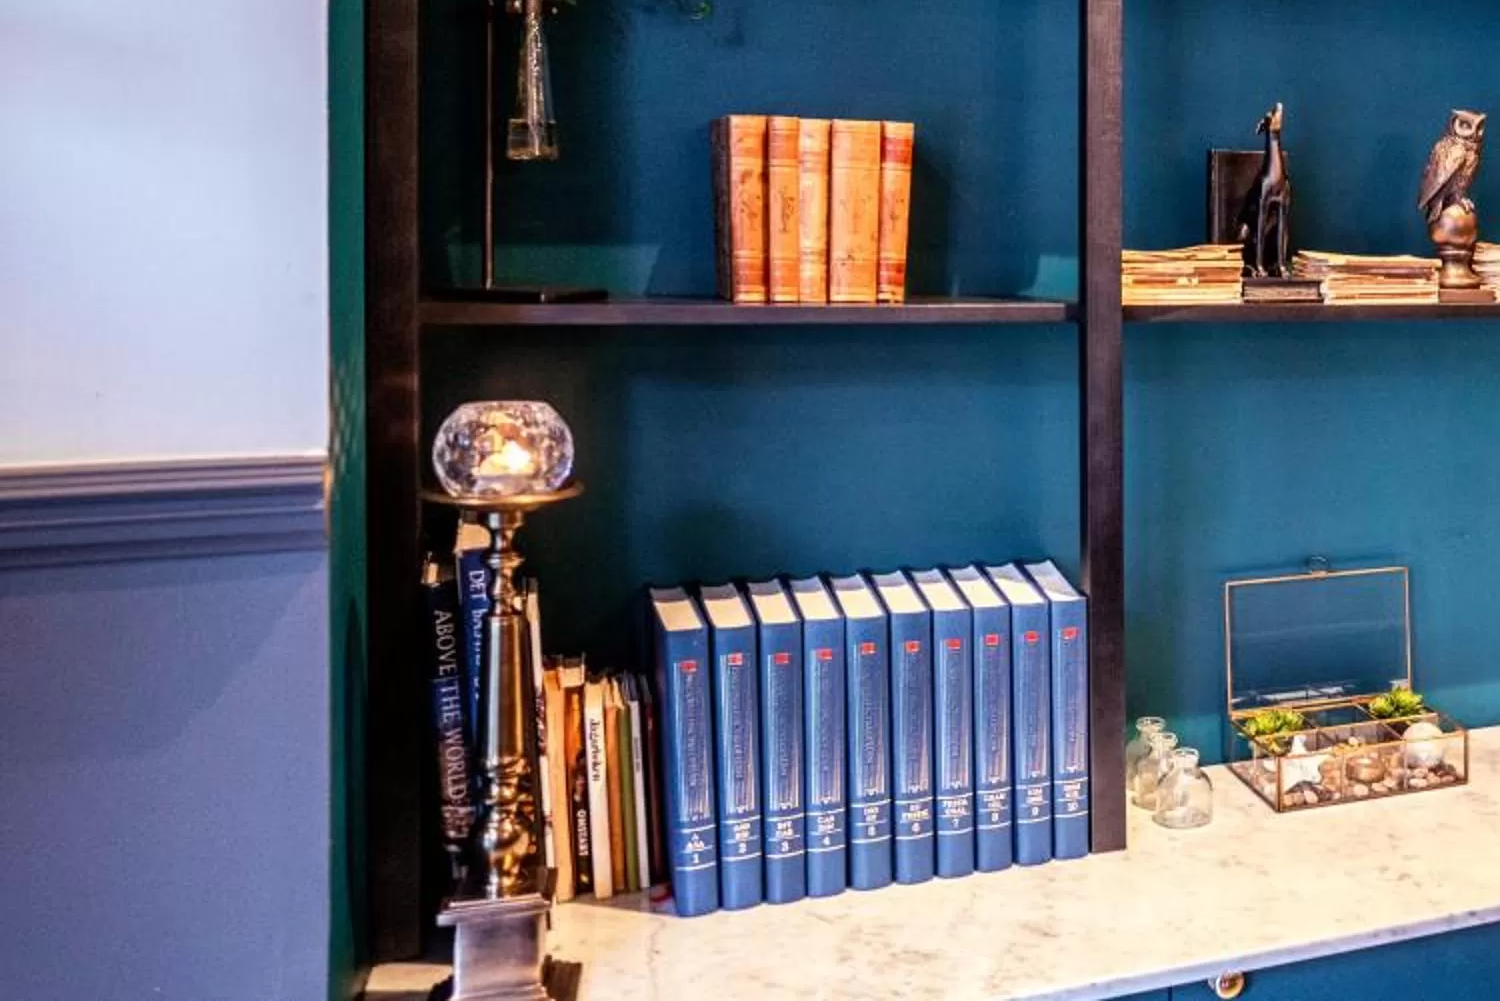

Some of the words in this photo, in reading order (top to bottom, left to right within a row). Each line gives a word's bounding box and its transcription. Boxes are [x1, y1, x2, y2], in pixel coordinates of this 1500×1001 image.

[468, 569, 487, 601] DET
[433, 610, 457, 676] ABOVE
[440, 684, 461, 723] THE
[444, 727, 468, 799] WORLD
